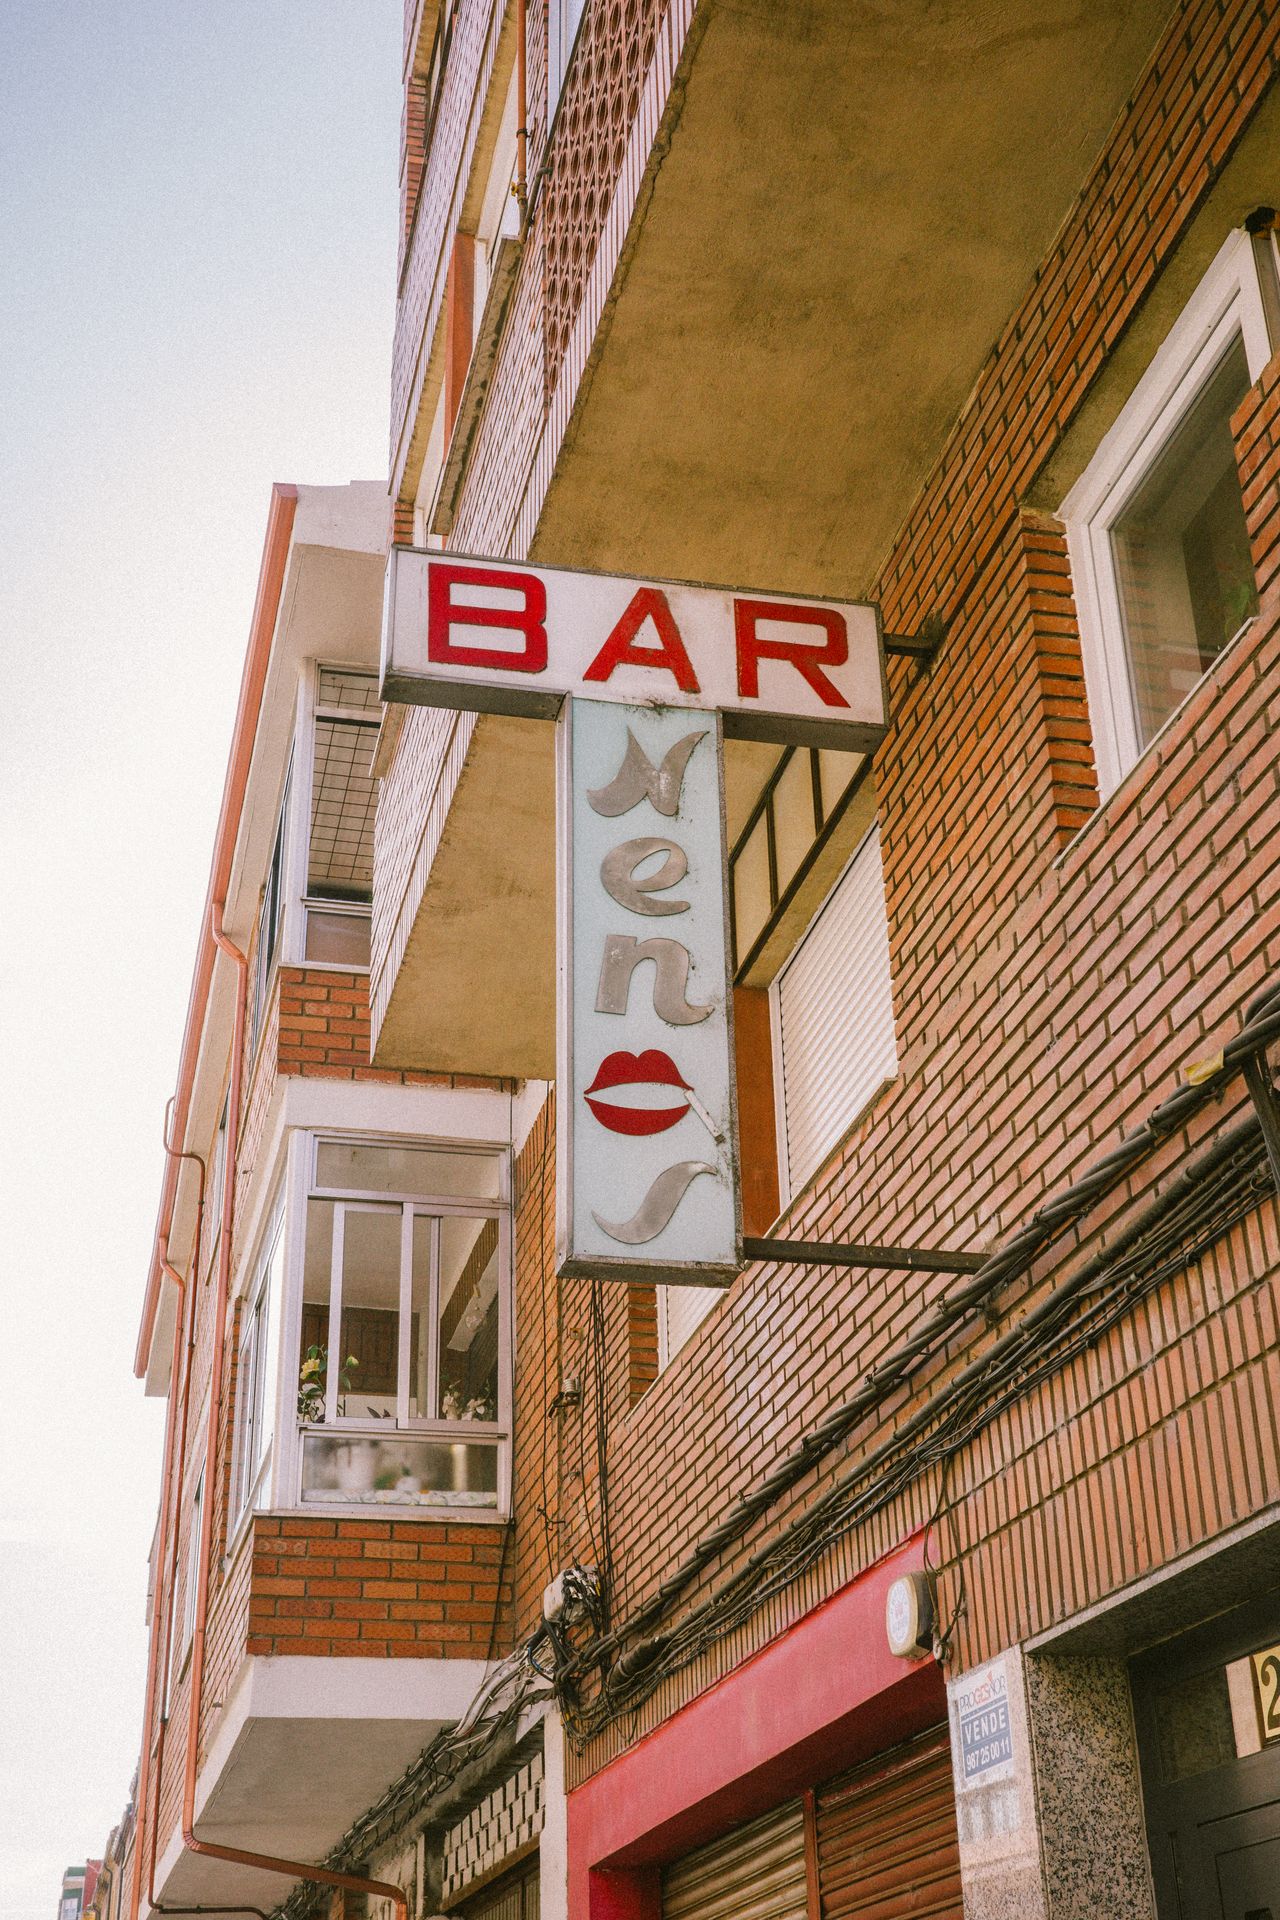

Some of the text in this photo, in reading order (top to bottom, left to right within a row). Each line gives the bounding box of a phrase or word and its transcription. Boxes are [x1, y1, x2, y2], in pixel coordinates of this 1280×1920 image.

[427, 562, 851, 709] BAR
[964, 1707, 1007, 1745] VENDE
[966, 1736, 1010, 1771] 987 25 00 11
